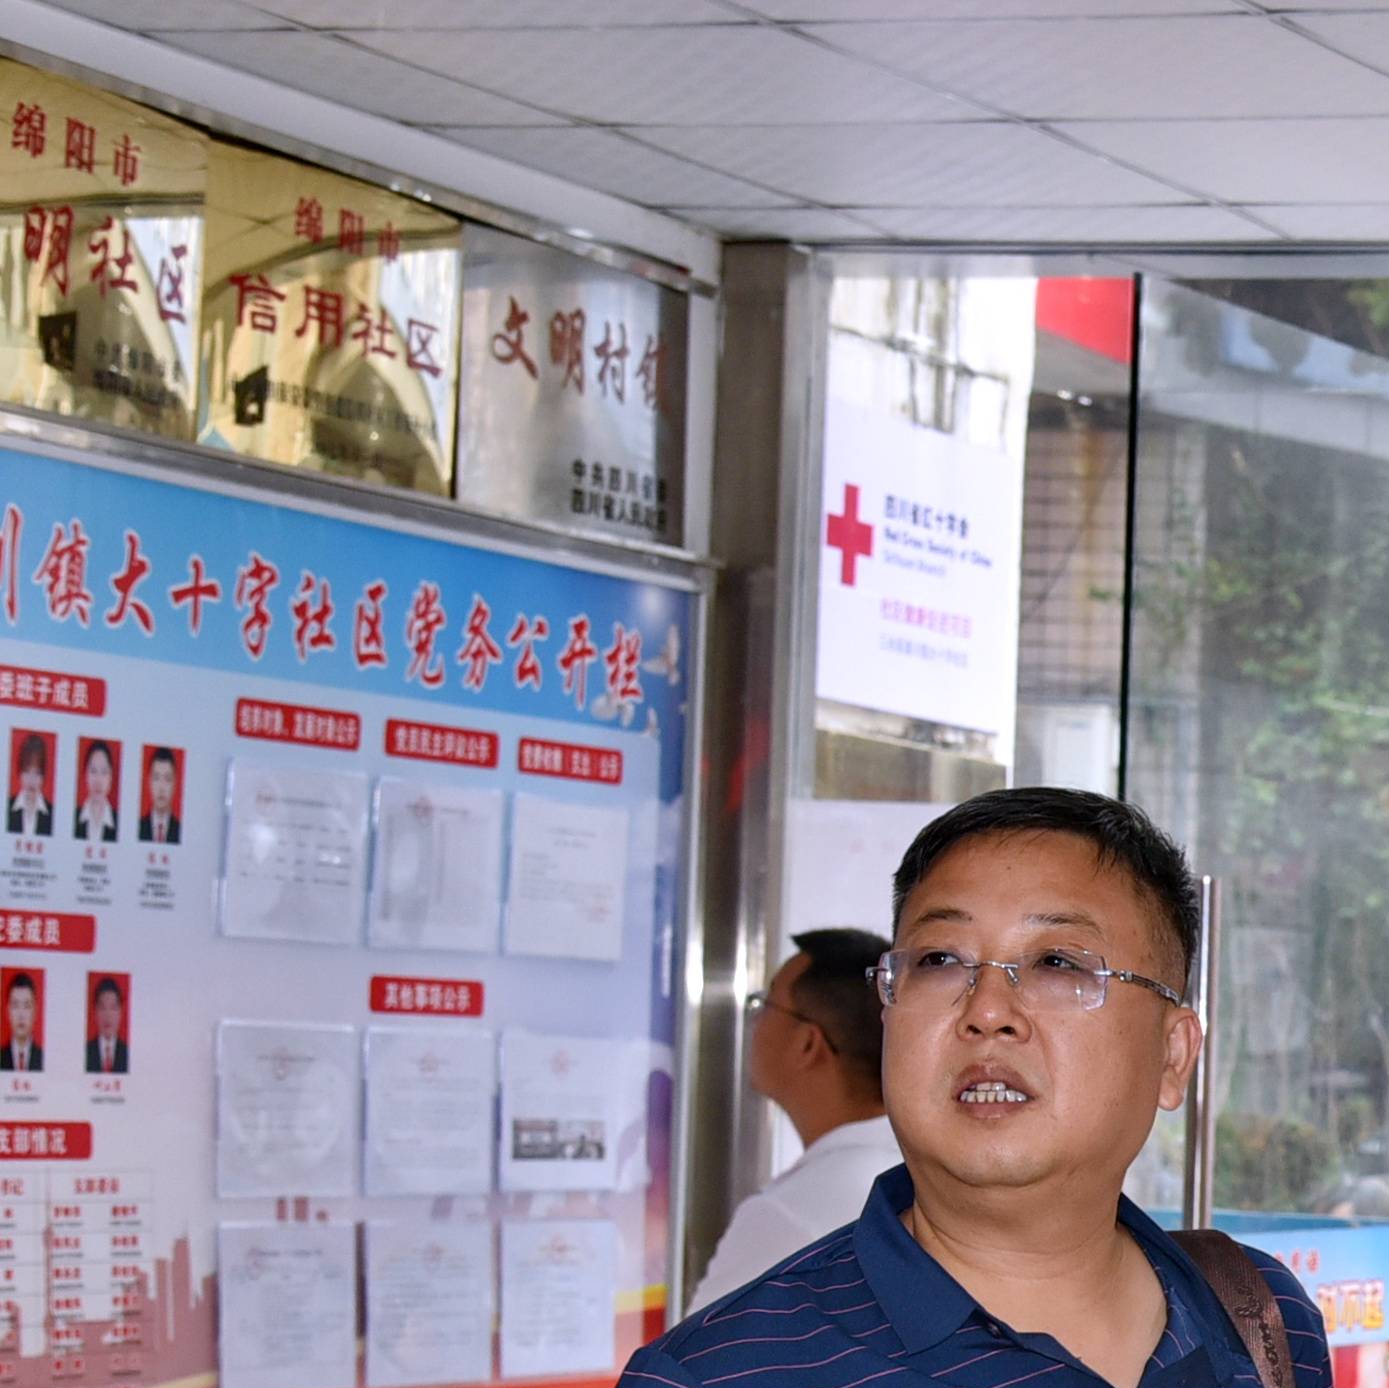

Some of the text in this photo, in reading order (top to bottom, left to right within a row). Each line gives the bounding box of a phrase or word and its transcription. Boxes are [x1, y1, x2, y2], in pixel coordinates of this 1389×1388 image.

[11, 101, 142, 187] 绵阳市
[23, 203, 188, 324] 明社区
[294, 196, 400, 265] 绵阳市
[229, 272, 443, 379] 信用社区
[492, 295, 673, 418] 文明村镇
[0, 916, 61, 945] 委成员
[384, 982, 471, 1012] 其他事项公示
